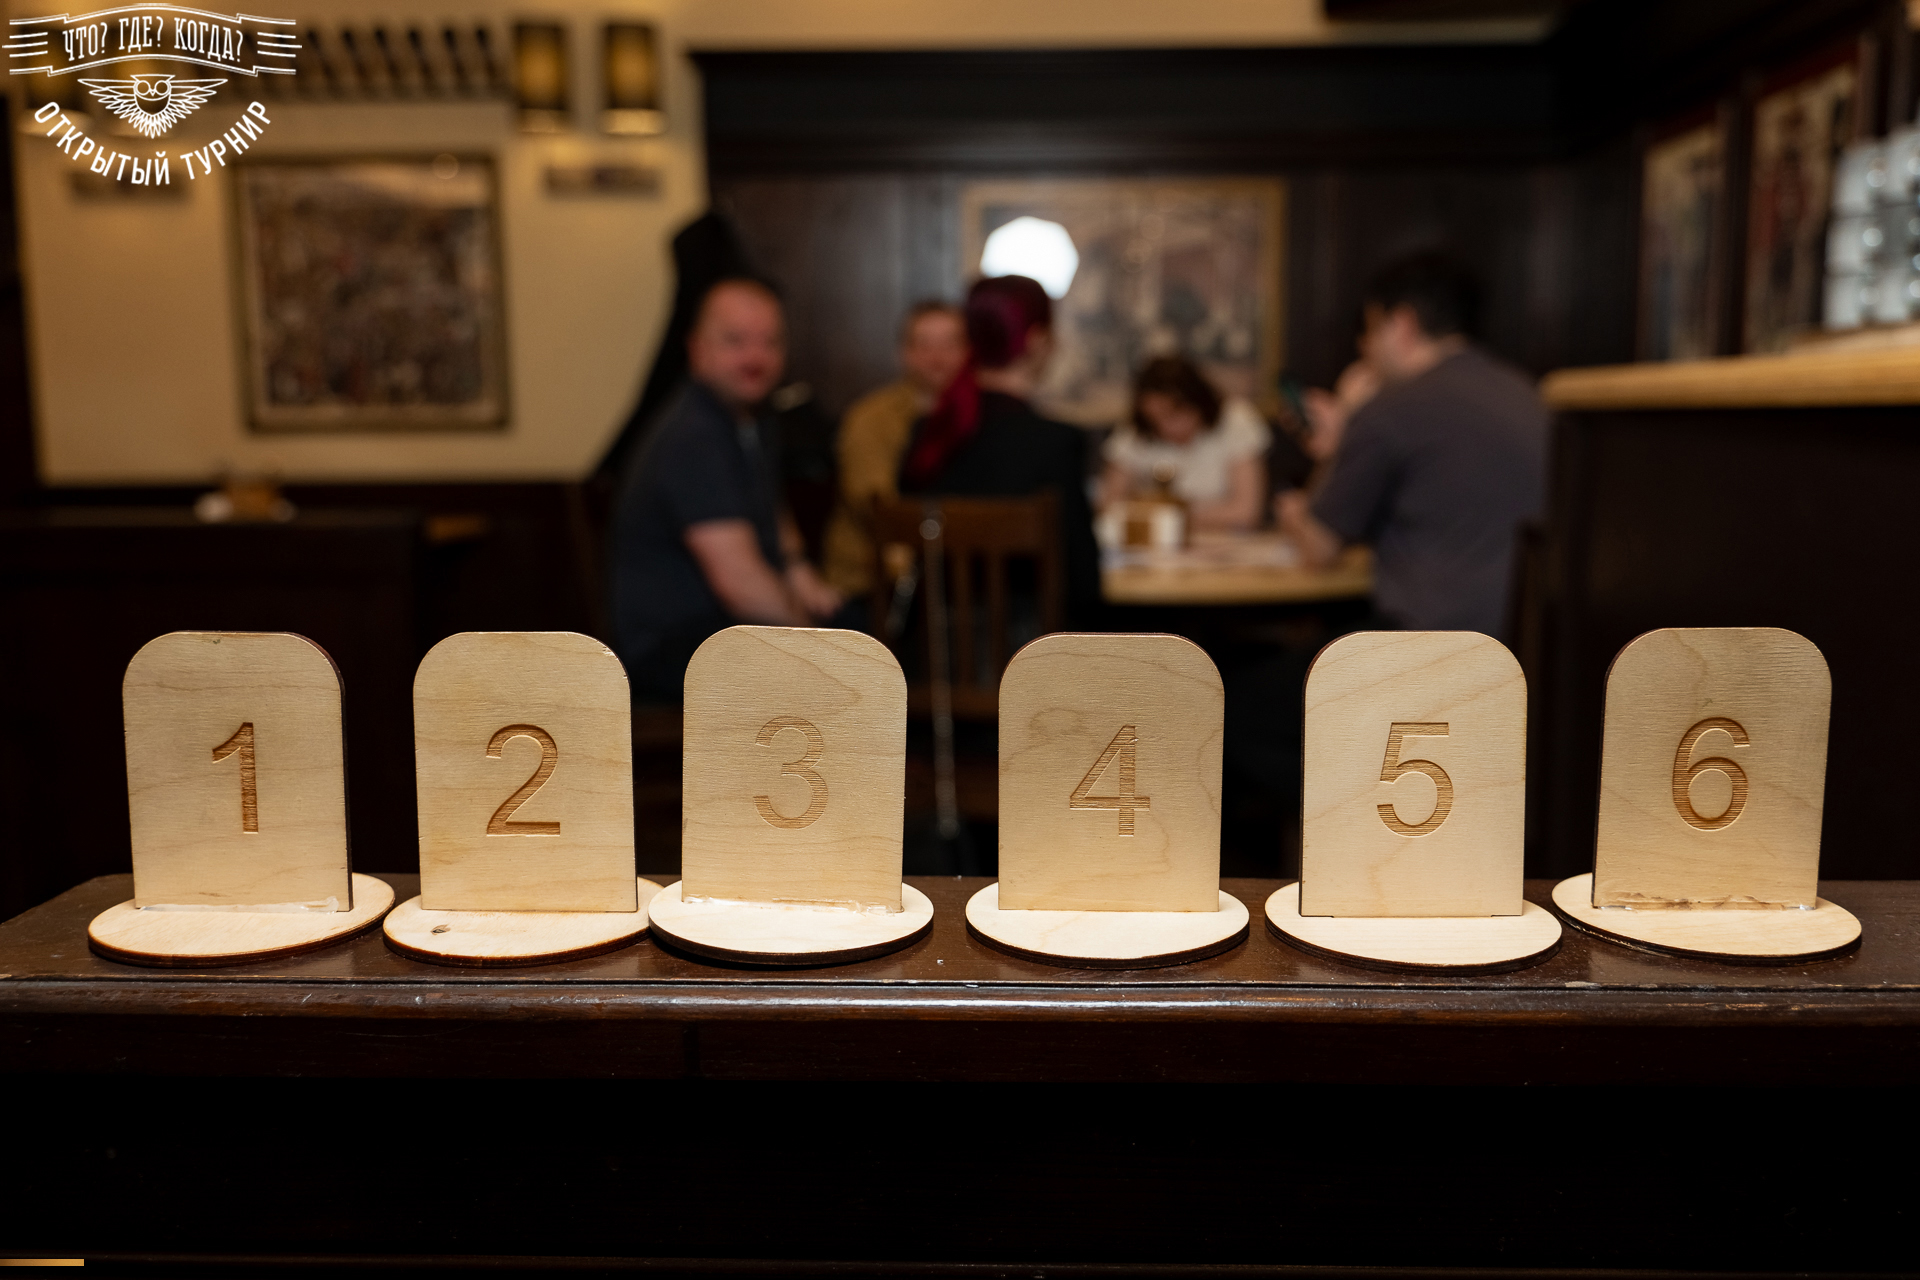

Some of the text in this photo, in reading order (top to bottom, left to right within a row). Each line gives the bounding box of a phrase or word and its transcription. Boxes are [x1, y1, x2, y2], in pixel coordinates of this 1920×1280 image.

[212, 721, 259, 834] 1
[486, 723, 561, 837] 2
[753, 715, 829, 830] 3
[1069, 724, 1151, 837] 4
[1376, 721, 1454, 838] 5
[1672, 716, 1751, 831] 6
